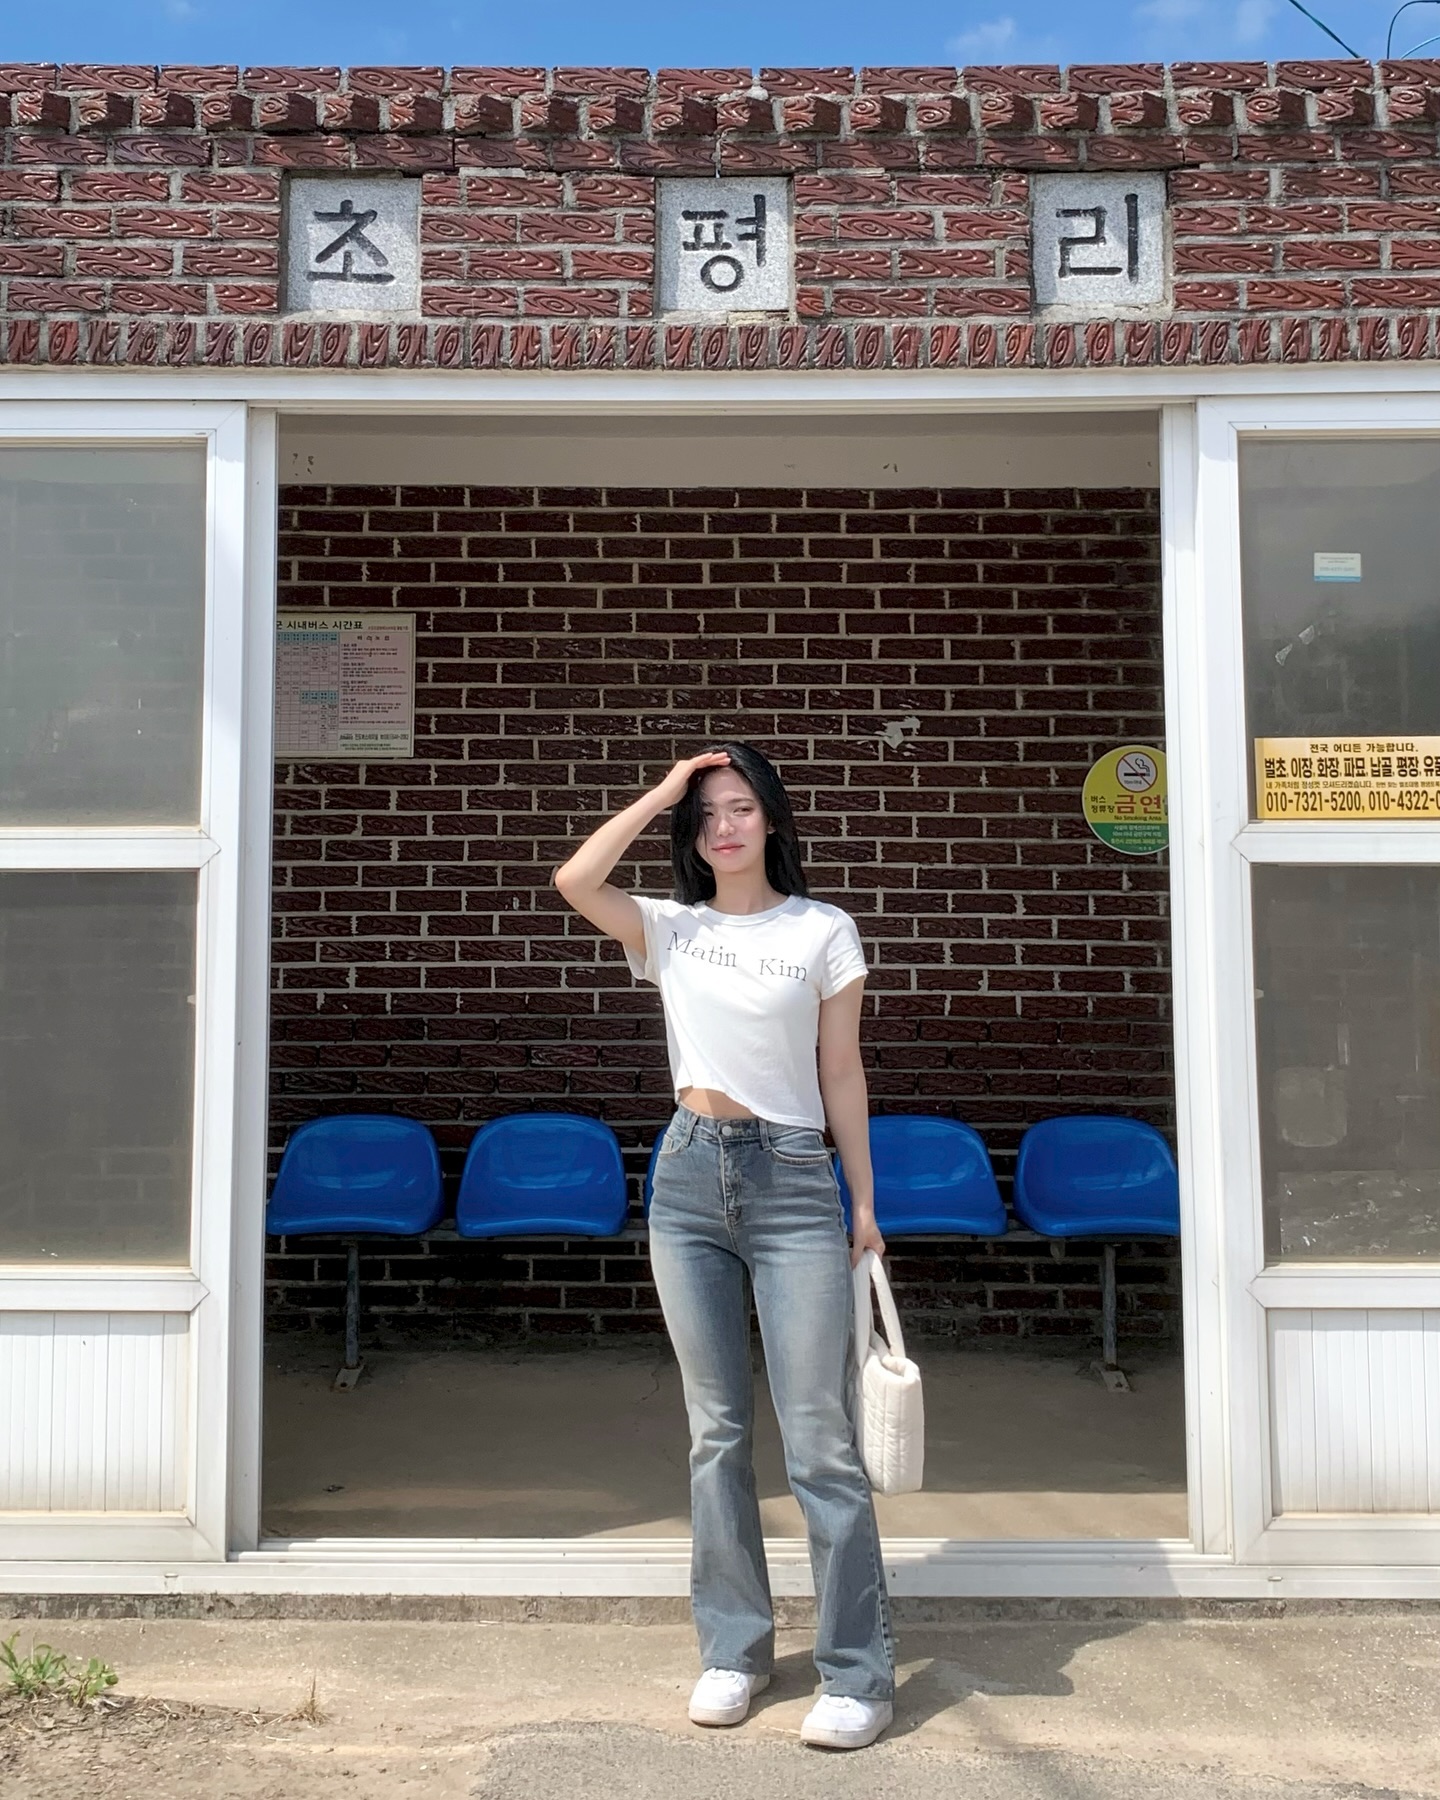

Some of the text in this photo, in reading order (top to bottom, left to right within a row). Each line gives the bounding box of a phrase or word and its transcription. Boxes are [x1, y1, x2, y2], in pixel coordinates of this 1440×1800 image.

[306, 193, 1139, 294] 초 평 리
[286, 620, 329, 630] 시내버스
[332, 620, 363, 630] 시간표
[1310, 742, 1419, 753] 전국 어디든 가능합니다.
[1090, 795, 1106, 803] 버스
[1114, 794, 1161, 814] 금연
[1266, 791, 1365, 813] 010-7321-5200,
[1091, 805, 1115, 814] 정류장
[666, 930, 807, 982] Matin Kim
